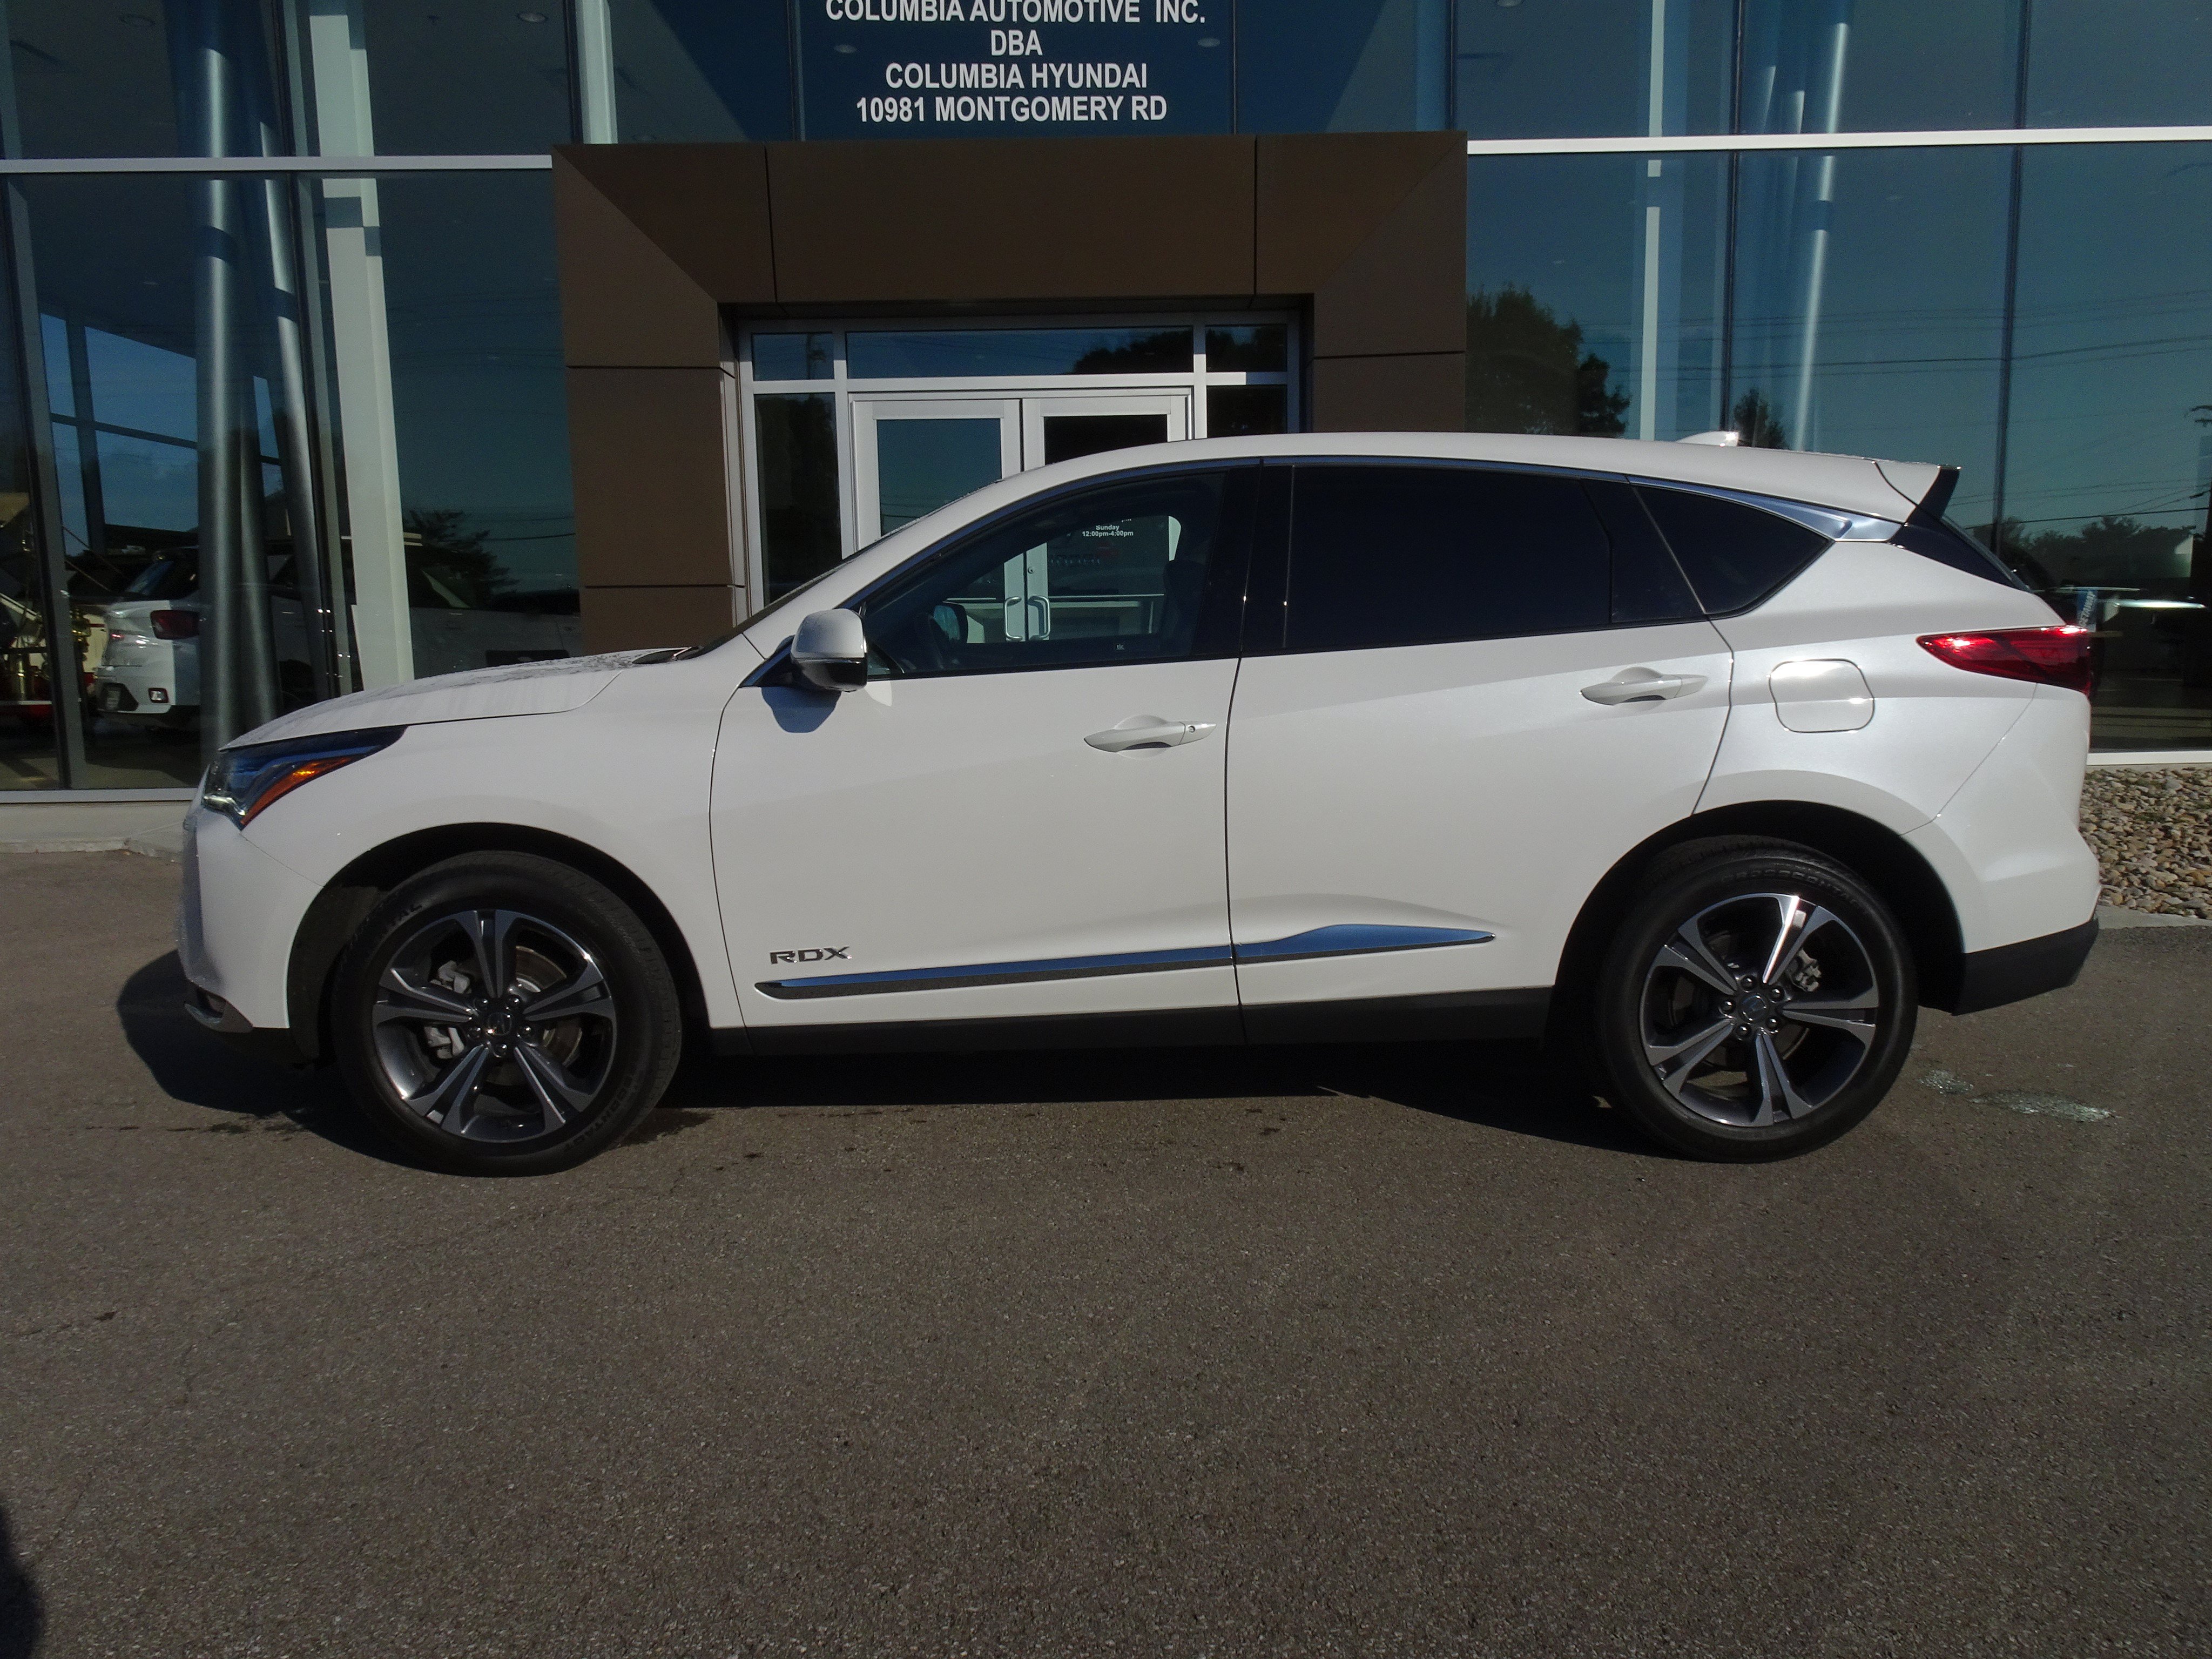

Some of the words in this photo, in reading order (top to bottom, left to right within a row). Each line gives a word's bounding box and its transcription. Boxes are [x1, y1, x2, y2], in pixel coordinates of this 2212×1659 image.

[826, 0, 965, 23] COLUMBIA
[970, 0, 1139, 23] AUTOMOTIVE
[1156, 0, 1205, 23] INC.
[991, 30, 1043, 56] DBA
[886, 64, 1024, 89] COLUMBIA
[1031, 63, 1147, 89] HYUNDAI
[857, 98, 925, 123] 10981
[936, 97, 1123, 122] MONTGOMERY
[1131, 96, 1167, 121] RD
[770, 946, 852, 965] RDX
